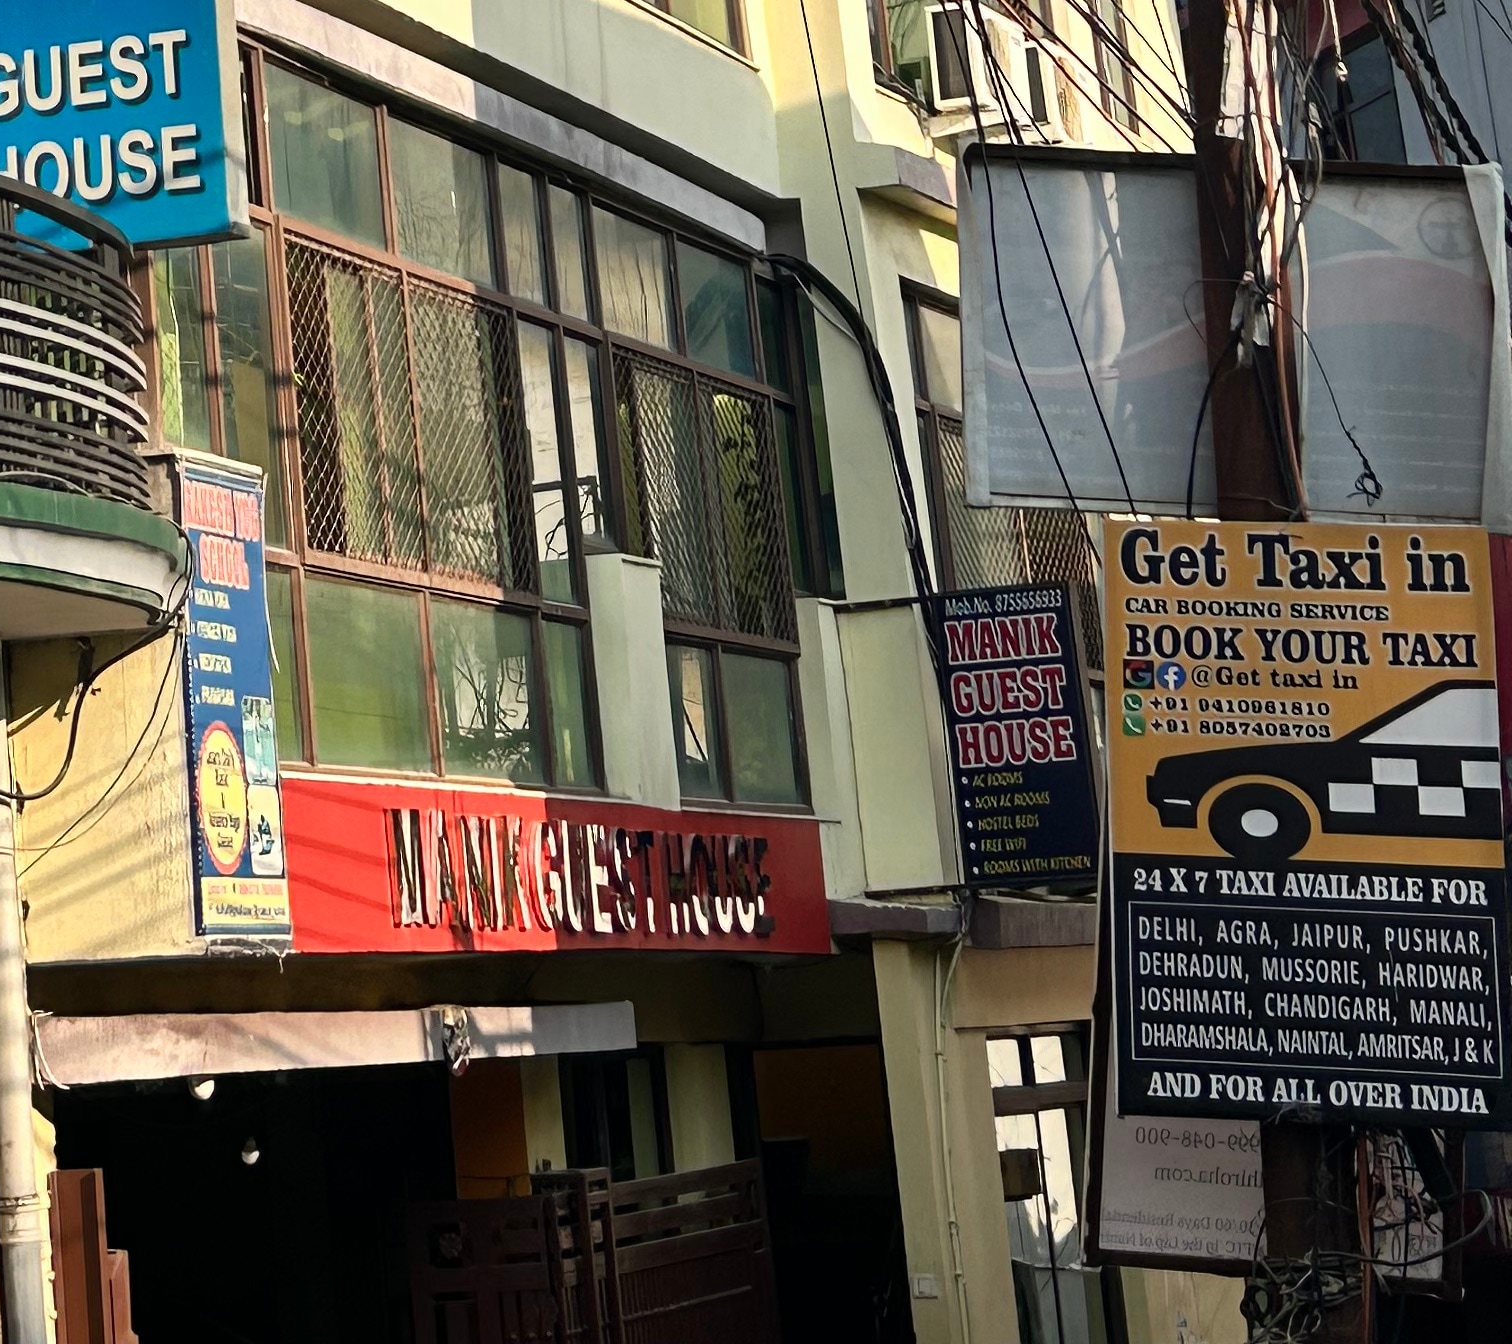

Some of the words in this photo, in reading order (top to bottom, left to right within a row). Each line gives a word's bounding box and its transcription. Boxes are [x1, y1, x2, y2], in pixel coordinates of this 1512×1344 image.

[199, 533, 250, 590] SCHOOL
[1121, 528, 1226, 587] Get
[1247, 533, 1386, 591] Taxi
[1407, 535, 1470, 593] in
[1125, 597, 1168, 614] CAR
[1176, 600, 1281, 619] BOOKING
[1290, 603, 1389, 621] SERVICE
[944, 613, 1062, 665] MANIK
[1125, 623, 1244, 662] BOOK
[1254, 628, 1370, 666] YOUR
[1382, 633, 1478, 668] TAXI
[950, 664, 1066, 717] GUEST
[1271, 669, 1322, 689] taxi
[1333, 670, 1358, 690] in
[1150, 696, 1189, 712] +91
[1150, 718, 1189, 734] +91
[955, 716, 1077, 768] HOUSE
[978, 816, 1013, 831] HOSTEL
[1015, 814, 1040, 828] BEDS
[531, 818, 654, 934] GUEST
[1134, 868, 1162, 892] 24
[1169, 868, 1189, 893] X
[1195, 871, 1209, 895] 7
[1216, 869, 1276, 897] TAXI
[1283, 873, 1424, 903] AVAILABLE
[1431, 878, 1488, 906] FOR
[1139, 916, 1203, 946] DELHI,
[1217, 920, 1279, 949] AGRA,
[1292, 923, 1371, 953] JAIPUR,
[1385, 927, 1488, 960] PUSHKAR,
[1139, 951, 1250, 983] DEHRADUN,
[1262, 957, 1366, 989] MUSSORIE,
[1379, 962, 1490, 995] HARIDWAR,
[1140, 987, 1253, 1019] JOSHIMATH,
[1265, 992, 1398, 1026] CHANDIGARH,
[1409, 999, 1493, 1031] MANALI,
[1142, 1023, 1273, 1056] DHARAMSHALA,
[1278, 1030, 1353, 1060] NAINTAL,
[1357, 1033, 1449, 1065] AMRITSAR,
[1452, 1037, 1461, 1062] J
[1465, 1039, 1479, 1061] &
[1483, 1040, 1495, 1064] K
[1147, 1071, 1202, 1099] AND
[1209, 1075, 1264, 1102] FOR
[1272, 1078, 1321, 1105] ALL
[1329, 1080, 1402, 1110] OVER
[1410, 1084, 1489, 1114] INDIA
